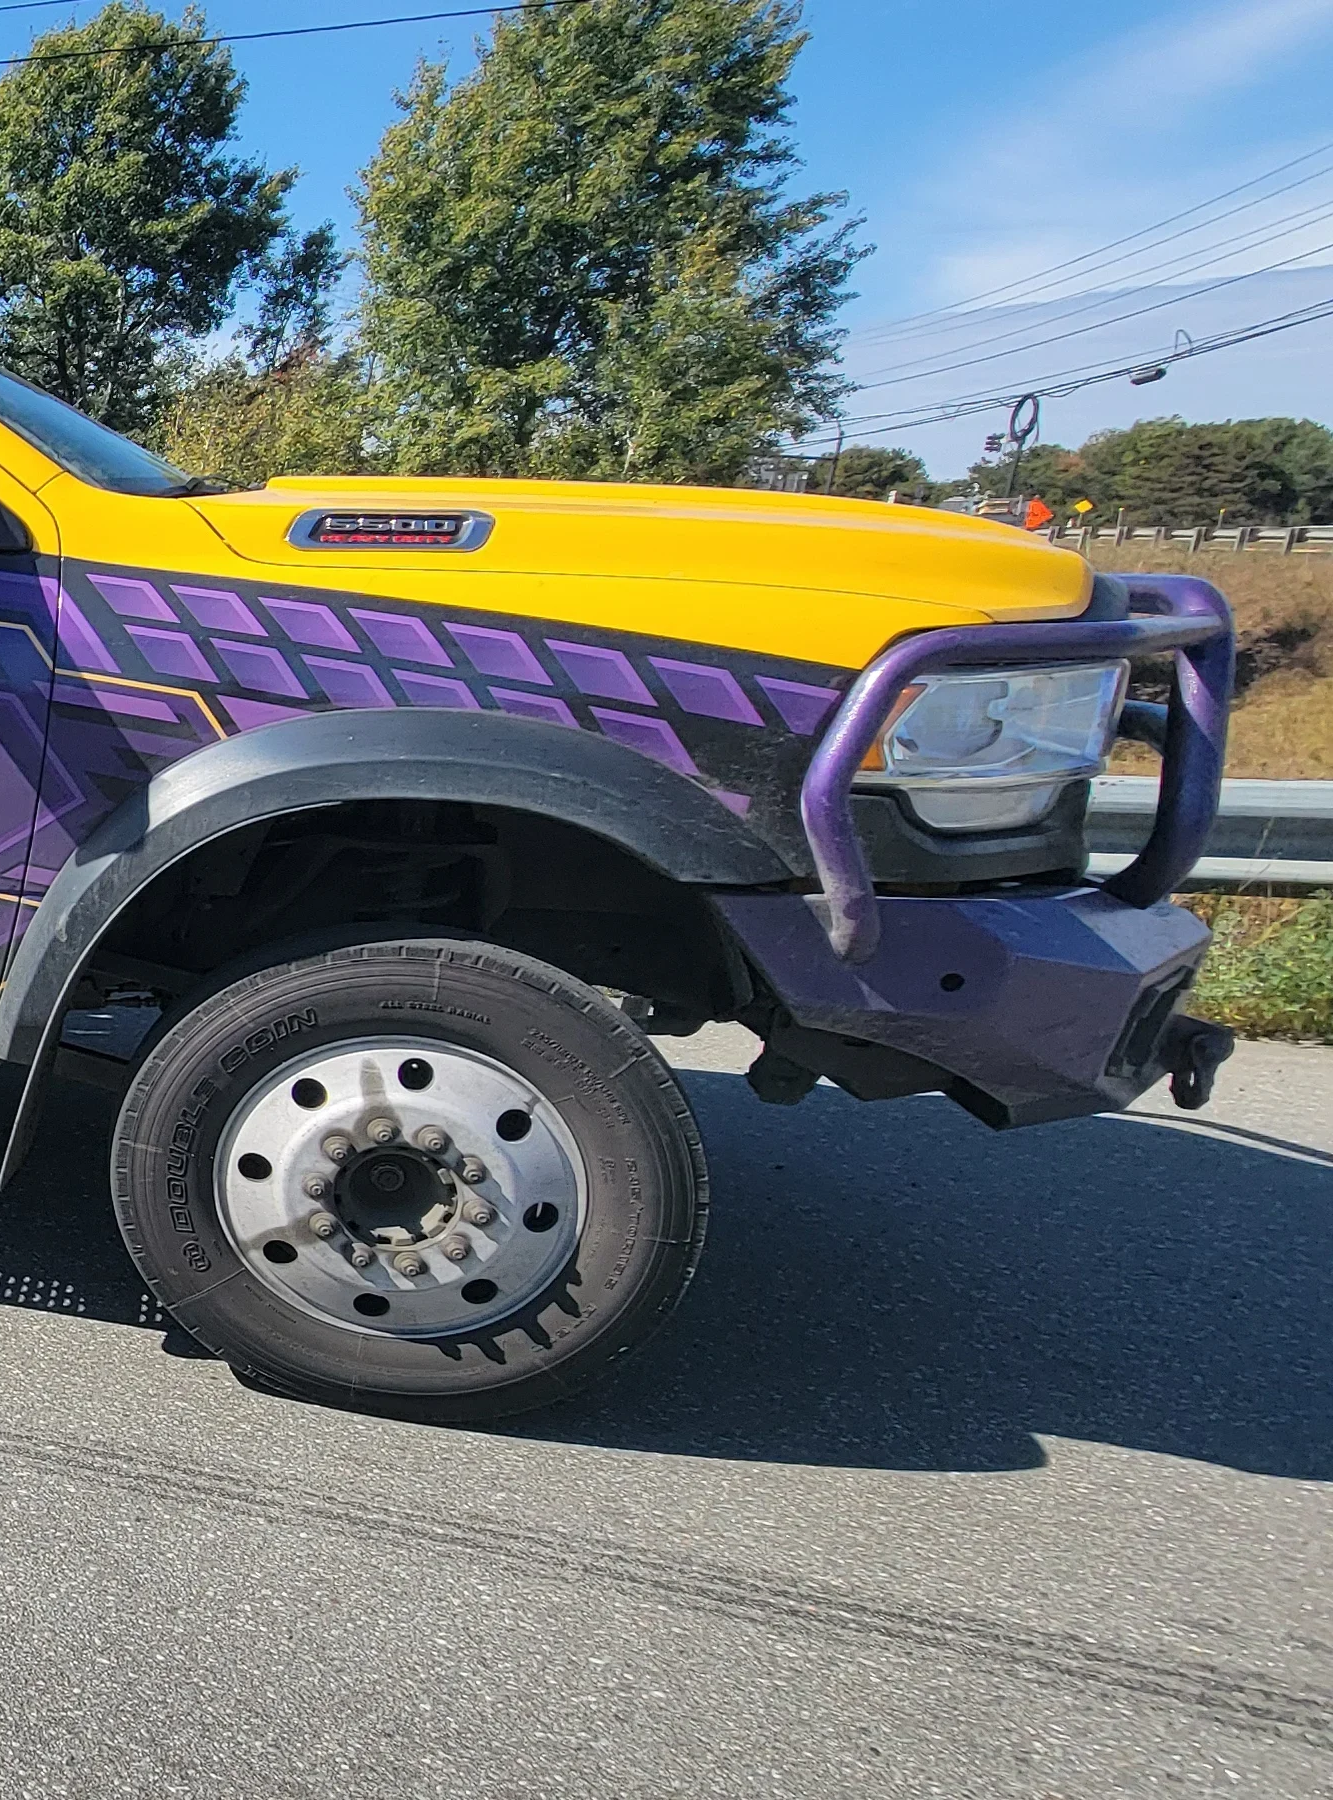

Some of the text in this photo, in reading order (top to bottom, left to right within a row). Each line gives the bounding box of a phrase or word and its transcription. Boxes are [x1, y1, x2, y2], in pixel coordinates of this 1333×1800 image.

[325, 517, 456, 532] 5500
[392, 535, 453, 544] DUTY
[166, 1007, 319, 1234] DOUBLE COIN
